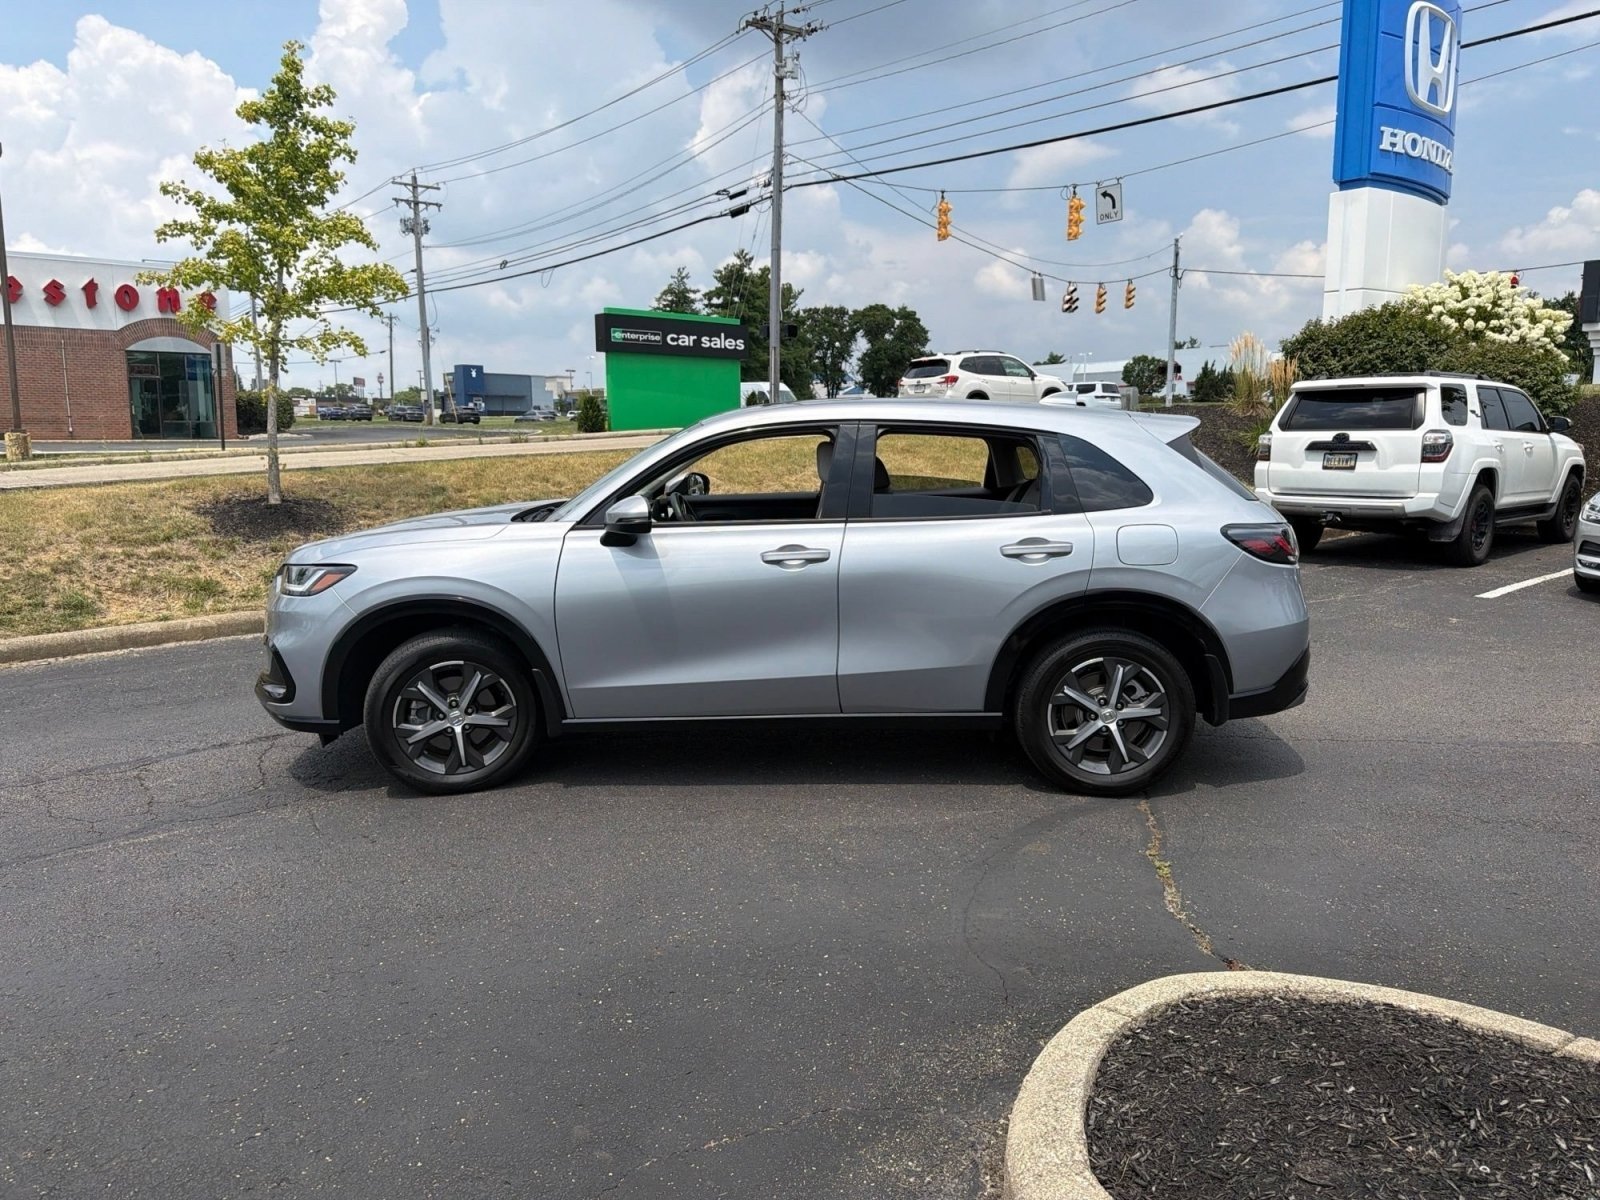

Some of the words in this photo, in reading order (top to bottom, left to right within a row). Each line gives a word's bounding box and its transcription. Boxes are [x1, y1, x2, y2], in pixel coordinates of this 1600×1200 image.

[1100, 210, 1118, 220] ONLY
[613, 331, 661, 342] enterprise
[666, 333, 697, 346] car
[701, 333, 745, 350] sales
